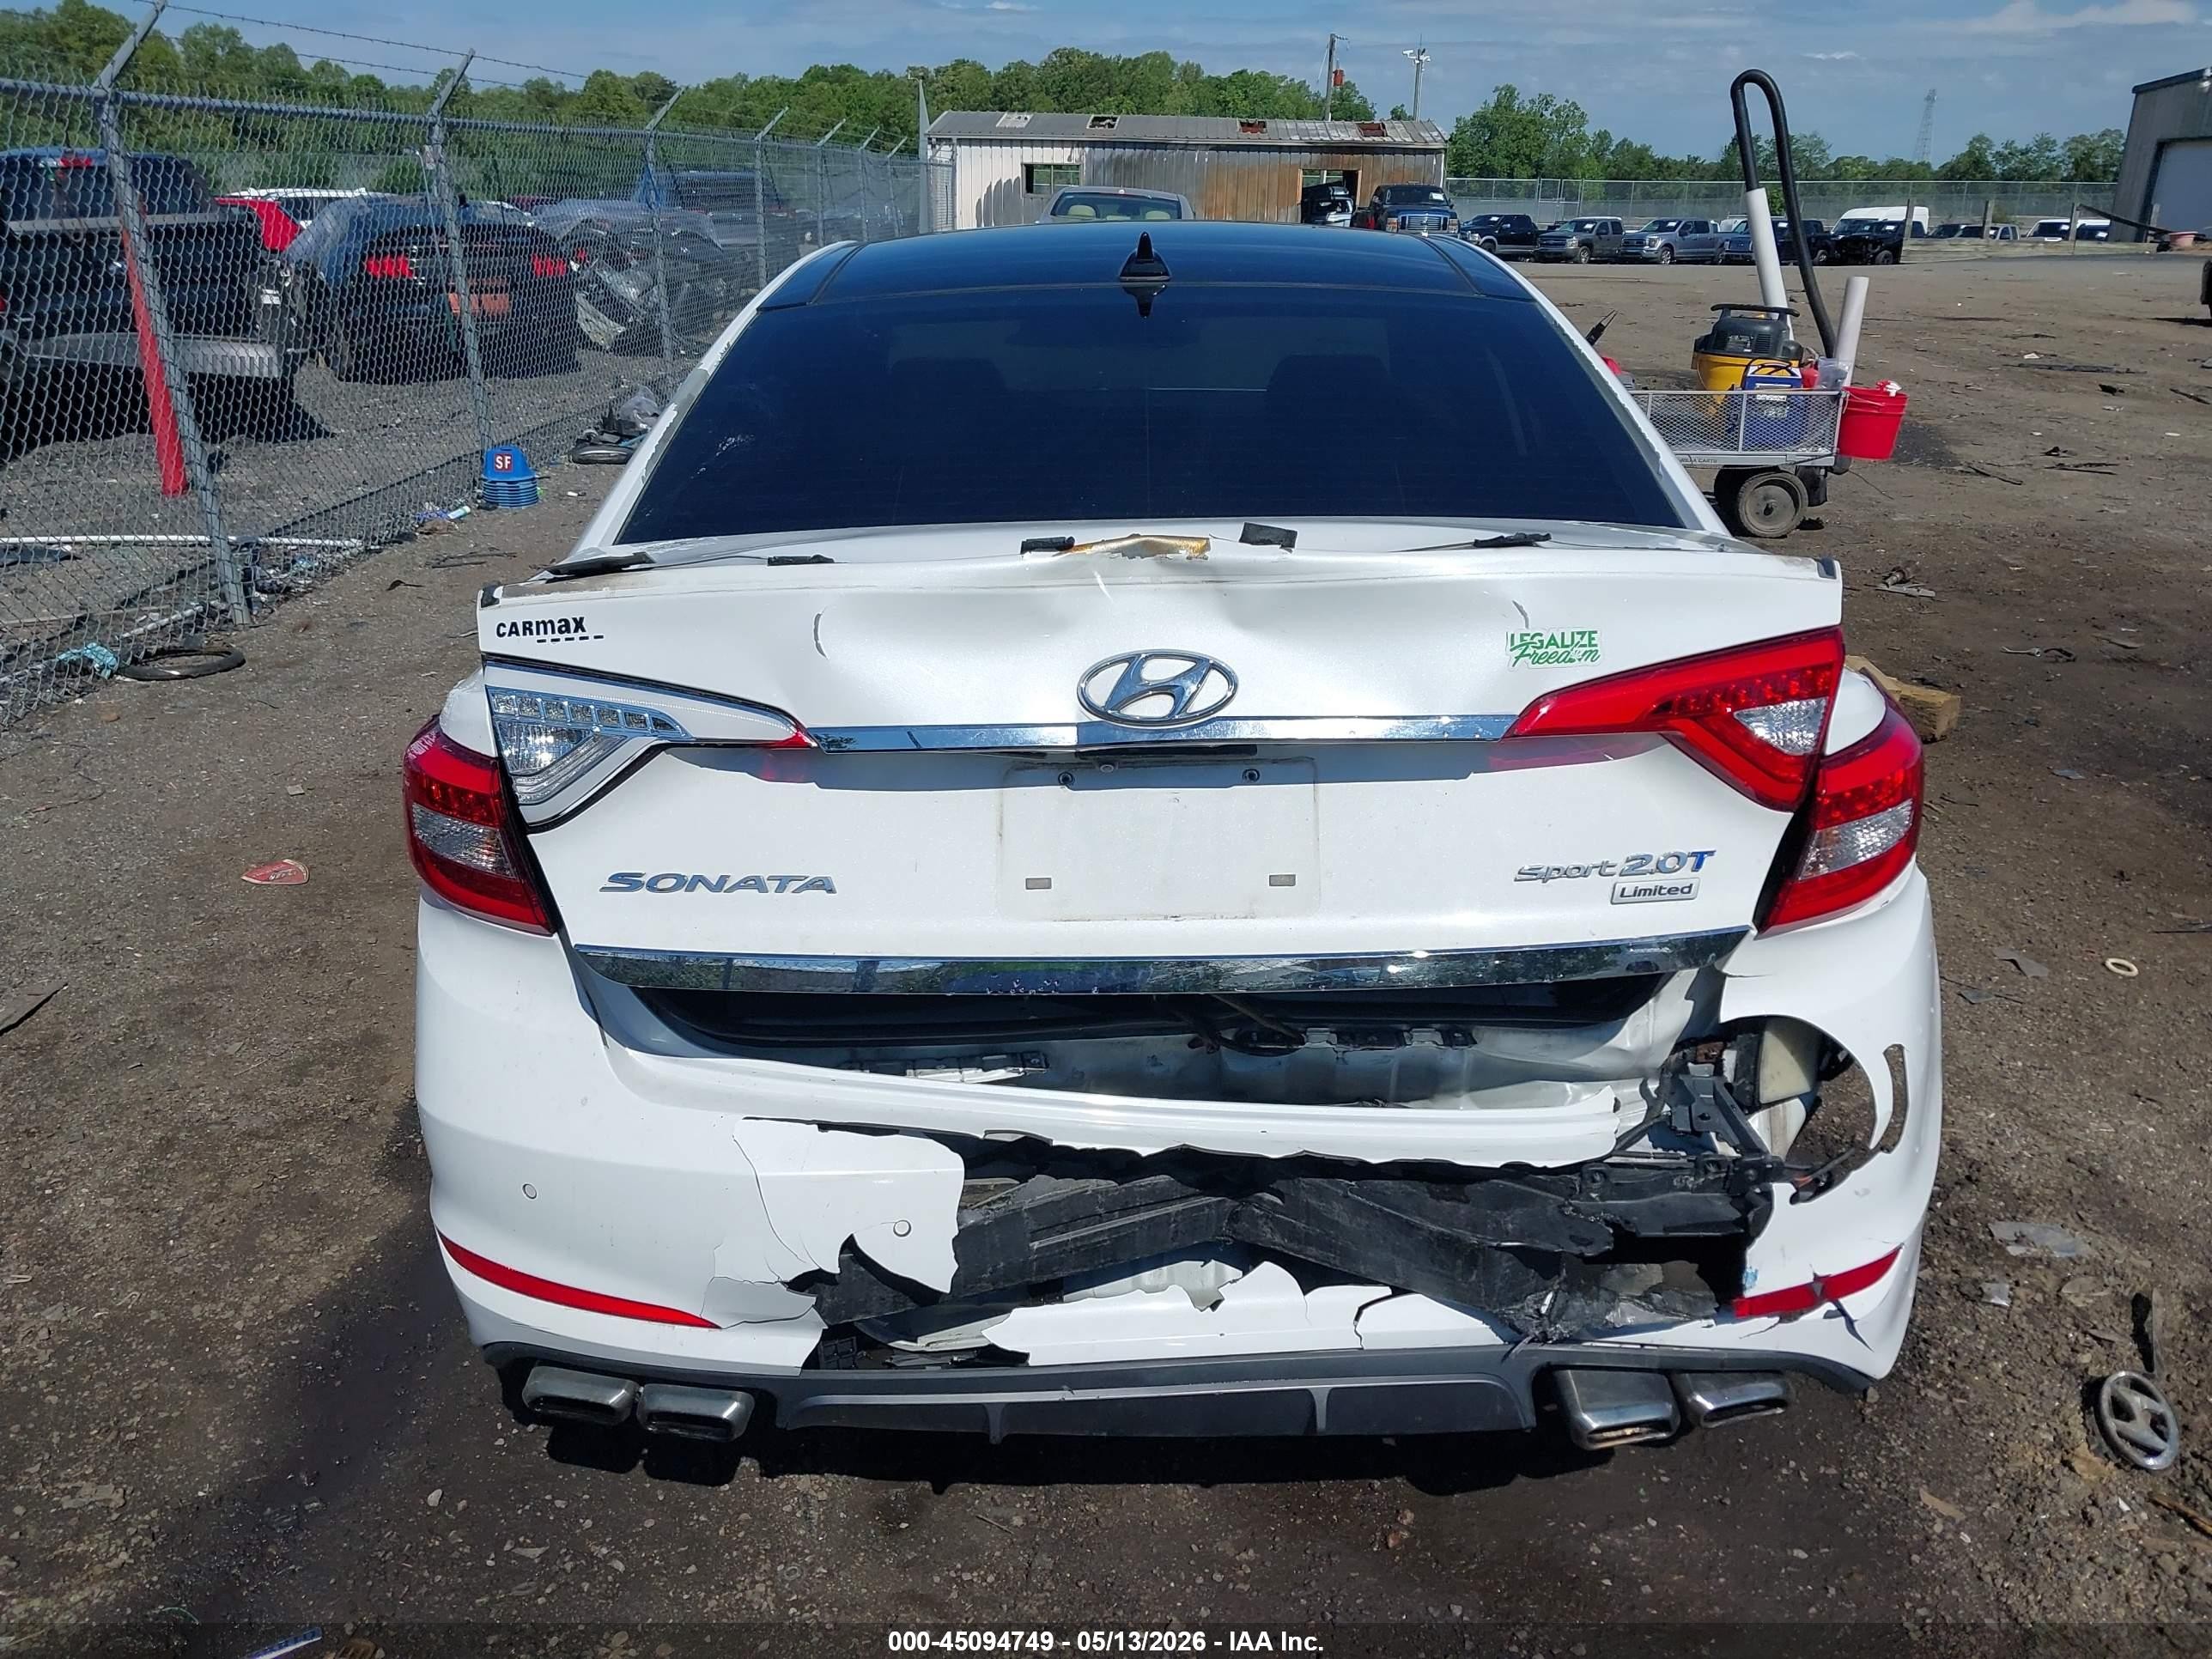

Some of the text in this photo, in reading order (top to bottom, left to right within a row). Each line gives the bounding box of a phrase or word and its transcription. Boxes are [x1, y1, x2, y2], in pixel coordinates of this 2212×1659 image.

[495, 455, 512, 470] SF
[495, 617, 586, 638] CARmax
[1510, 630, 1598, 649] LEGALIZE
[1510, 641, 1601, 667] Freedm
[1514, 849, 1717, 883] Sport 2.0T
[599, 872, 837, 894] SONATA
[1620, 884, 1693, 898] Limited
